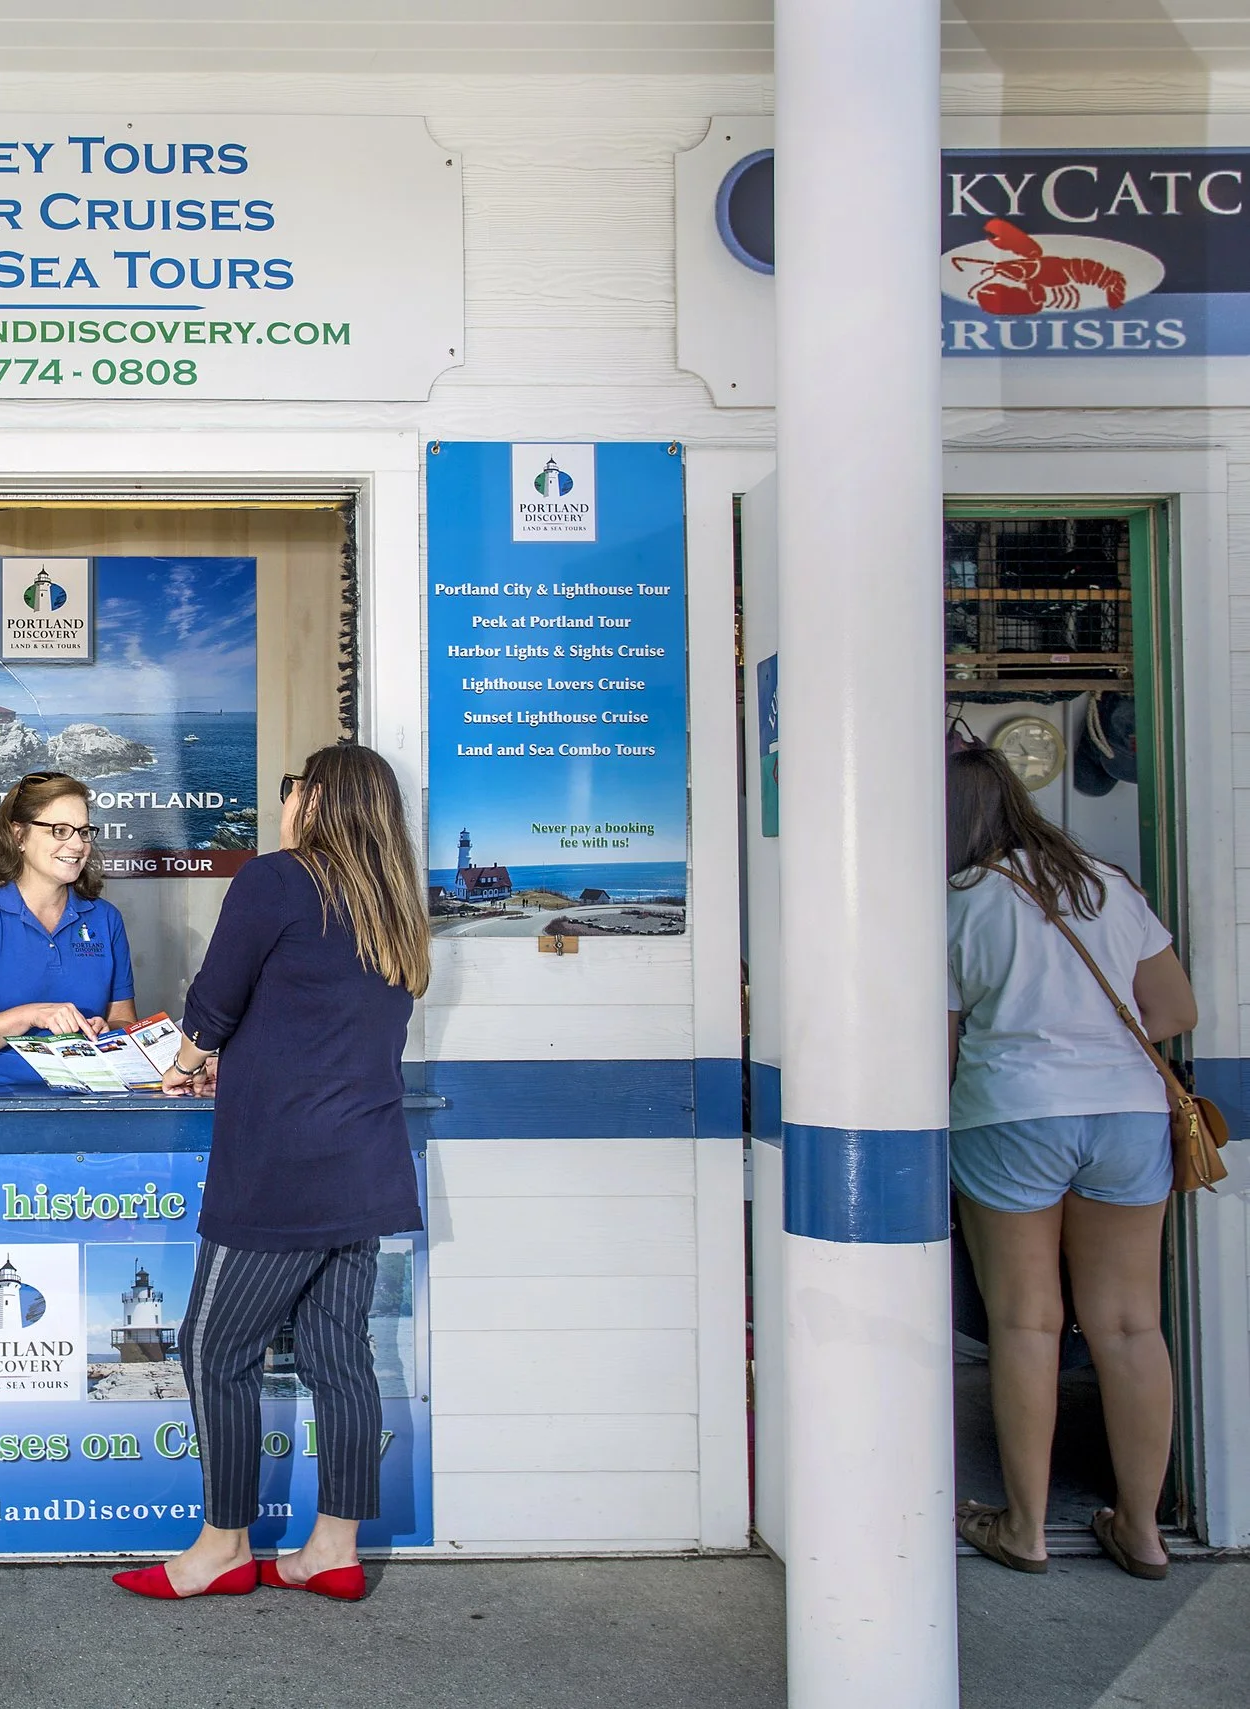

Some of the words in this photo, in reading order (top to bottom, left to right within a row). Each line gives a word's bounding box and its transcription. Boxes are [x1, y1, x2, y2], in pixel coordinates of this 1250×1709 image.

[68, 136, 248, 174] TOURS
[948, 166, 1243, 223] KYCATC
[40, 193, 274, 232] CRUISES
[114, 250, 293, 290] TOURS
[520, 504, 588, 513] PORTLAND
[435, 583, 498, 595] Portland
[503, 583, 532, 598] City
[536, 583, 548, 595] &
[553, 583, 633, 598] Lighthouse
[636, 583, 670, 595] Tour
[7, 619, 84, 629] PORTLAND
[473, 616, 508, 628] Peek
[512, 616, 526, 628] at
[530, 616, 594, 628] Portland
[598, 616, 631, 628] Tour
[13, 630, 78, 639] DISCOVERY
[448, 645, 501, 657] Harbor
[505, 645, 549, 661] Lights
[553, 645, 565, 657] &
[569, 645, 613, 661] Sights
[618, 645, 664, 657] Cruise
[463, 678, 542, 694] Lighthouse
[548, 679, 594, 691] Lovers
[598, 678, 645, 691] Cruise
[464, 712, 513, 724] Sunset
[517, 711, 597, 728] Lighthouse
[602, 711, 648, 724] Cruise
[458, 744, 492, 756] Land
[497, 744, 524, 756] and
[529, 744, 554, 756] Sea
[558, 744, 611, 756] Combo
[615, 744, 655, 756] Tours
[104, 823, 133, 839] IT.
[531, 823, 566, 834] Never
[570, 825, 591, 837] pay
[595, 825, 601, 834] a
[605, 823, 654, 837] booking
[560, 837, 579, 848] fee
[582, 837, 608, 848] with
[612, 837, 630, 848] us!
[162, 857, 213, 872] TOUR
[2, 1183, 185, 1220] historic
[83, 1432, 139, 1460] on
